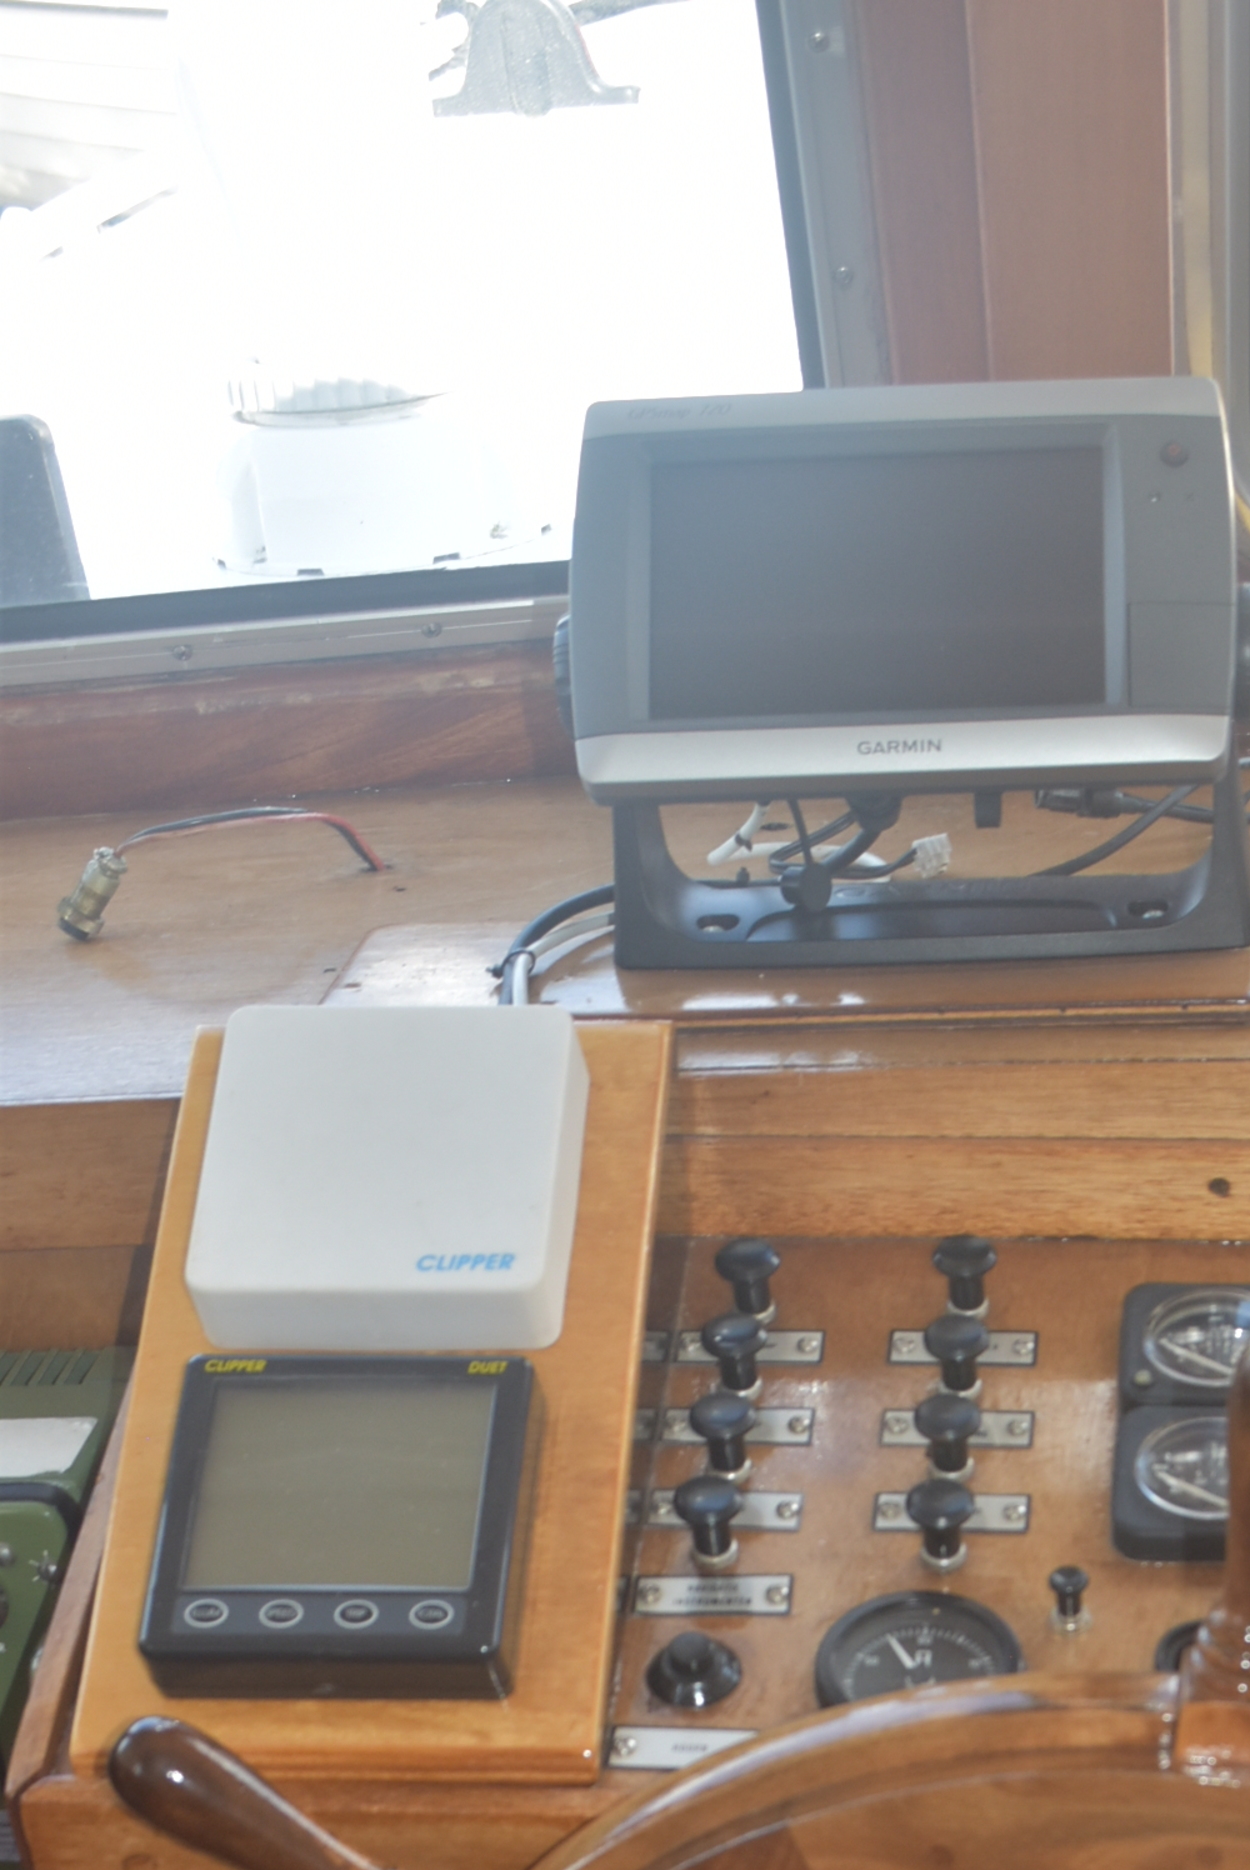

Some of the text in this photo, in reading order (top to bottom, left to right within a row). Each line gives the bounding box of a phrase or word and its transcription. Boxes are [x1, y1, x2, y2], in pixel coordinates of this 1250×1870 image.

[857, 738, 942, 756] GARMIN
[415, 1252, 517, 1272] CLIPPER
[204, 1359, 267, 1373] CLIPPER
[467, 1360, 508, 1374] DUET
